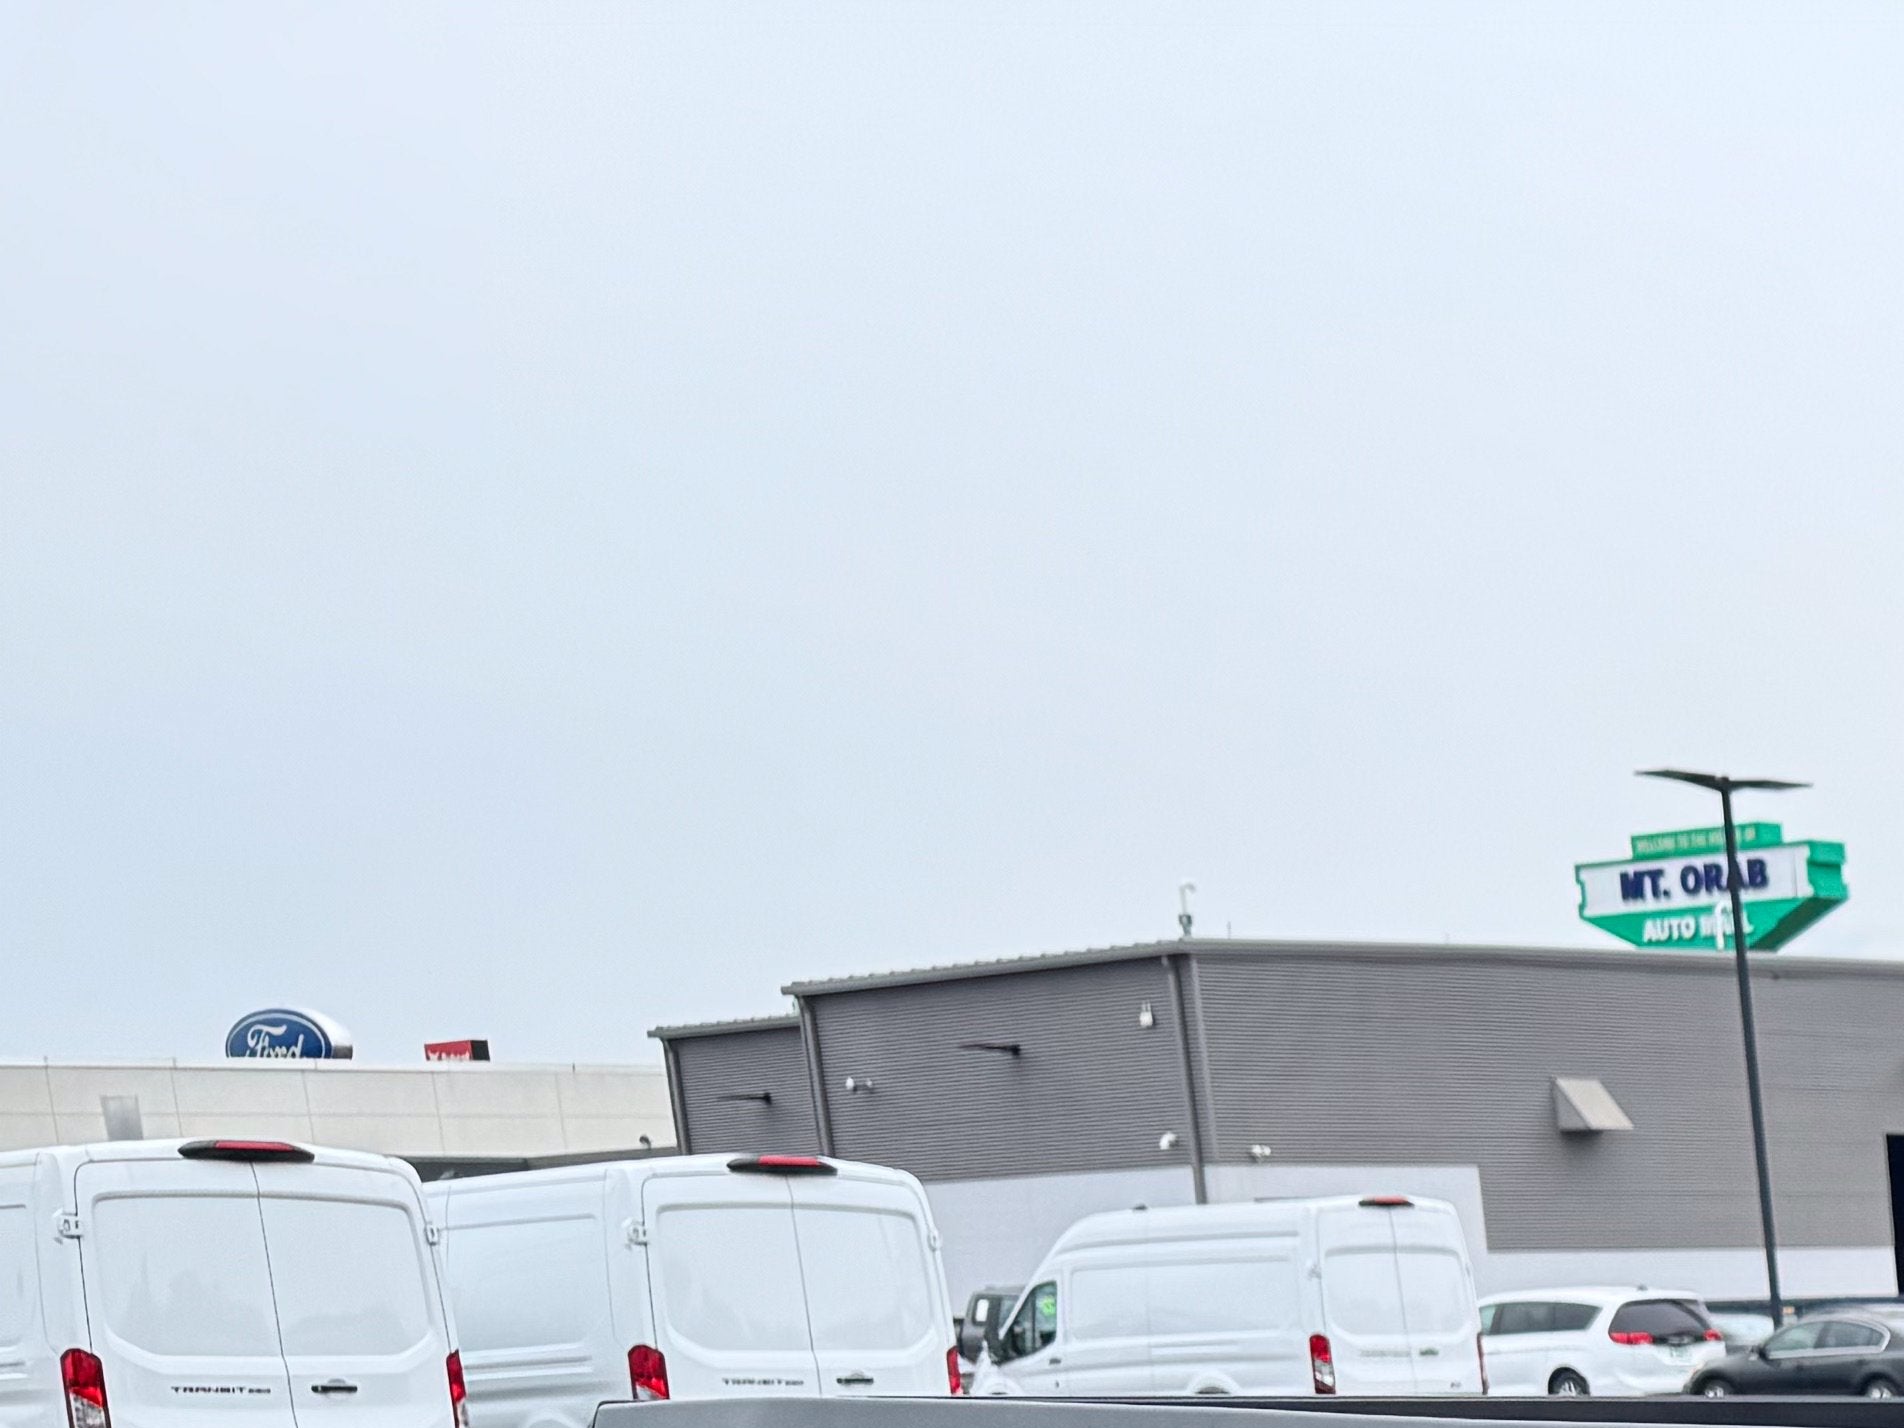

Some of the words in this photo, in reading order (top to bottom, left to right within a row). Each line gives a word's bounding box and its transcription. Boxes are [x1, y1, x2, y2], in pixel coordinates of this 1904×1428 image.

[1619, 868, 1670, 901] MT.
[1642, 914, 1697, 943] AUTO
[245, 1024, 304, 1059] Ford
